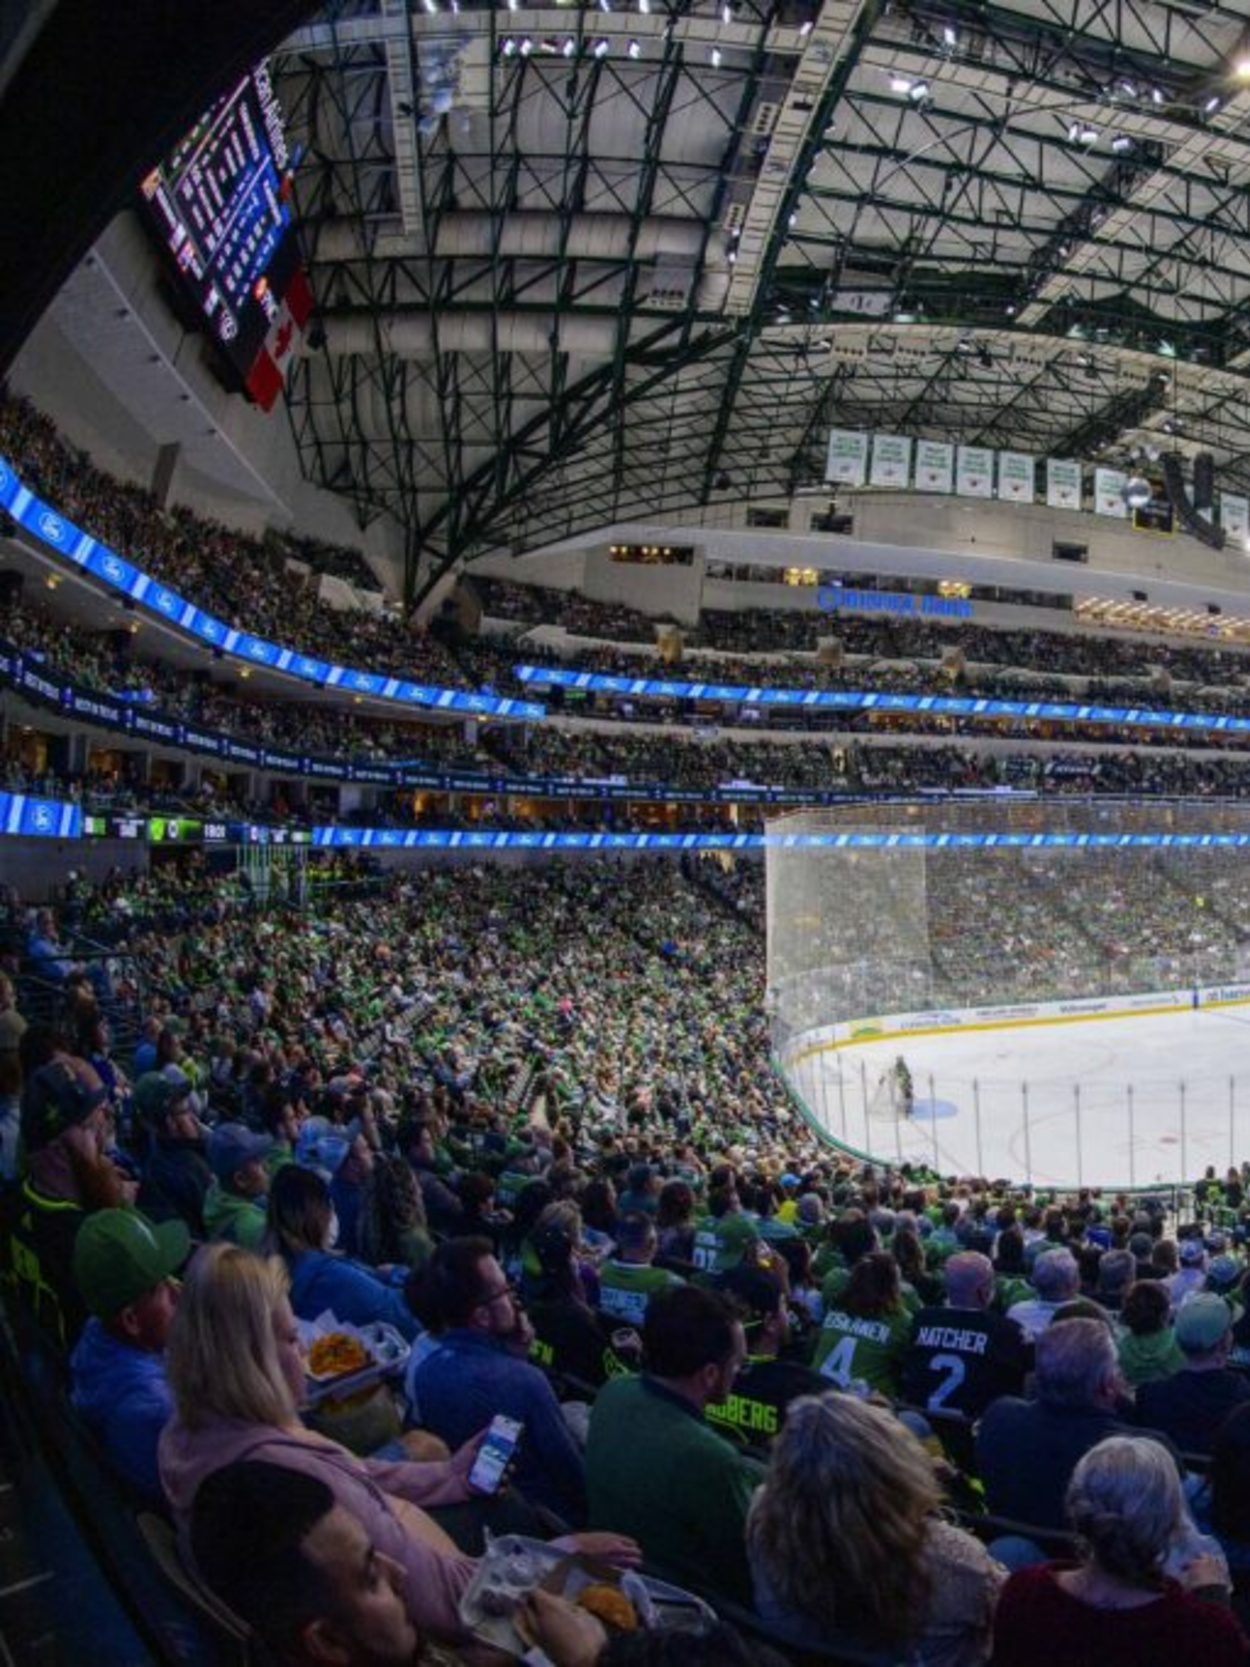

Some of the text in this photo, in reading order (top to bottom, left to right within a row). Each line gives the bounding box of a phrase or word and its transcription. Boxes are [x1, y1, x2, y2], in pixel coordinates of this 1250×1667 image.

[820, 1335, 857, 1387] 4
[915, 1326, 988, 1355] HATCHER
[926, 1353, 966, 1417] 2
